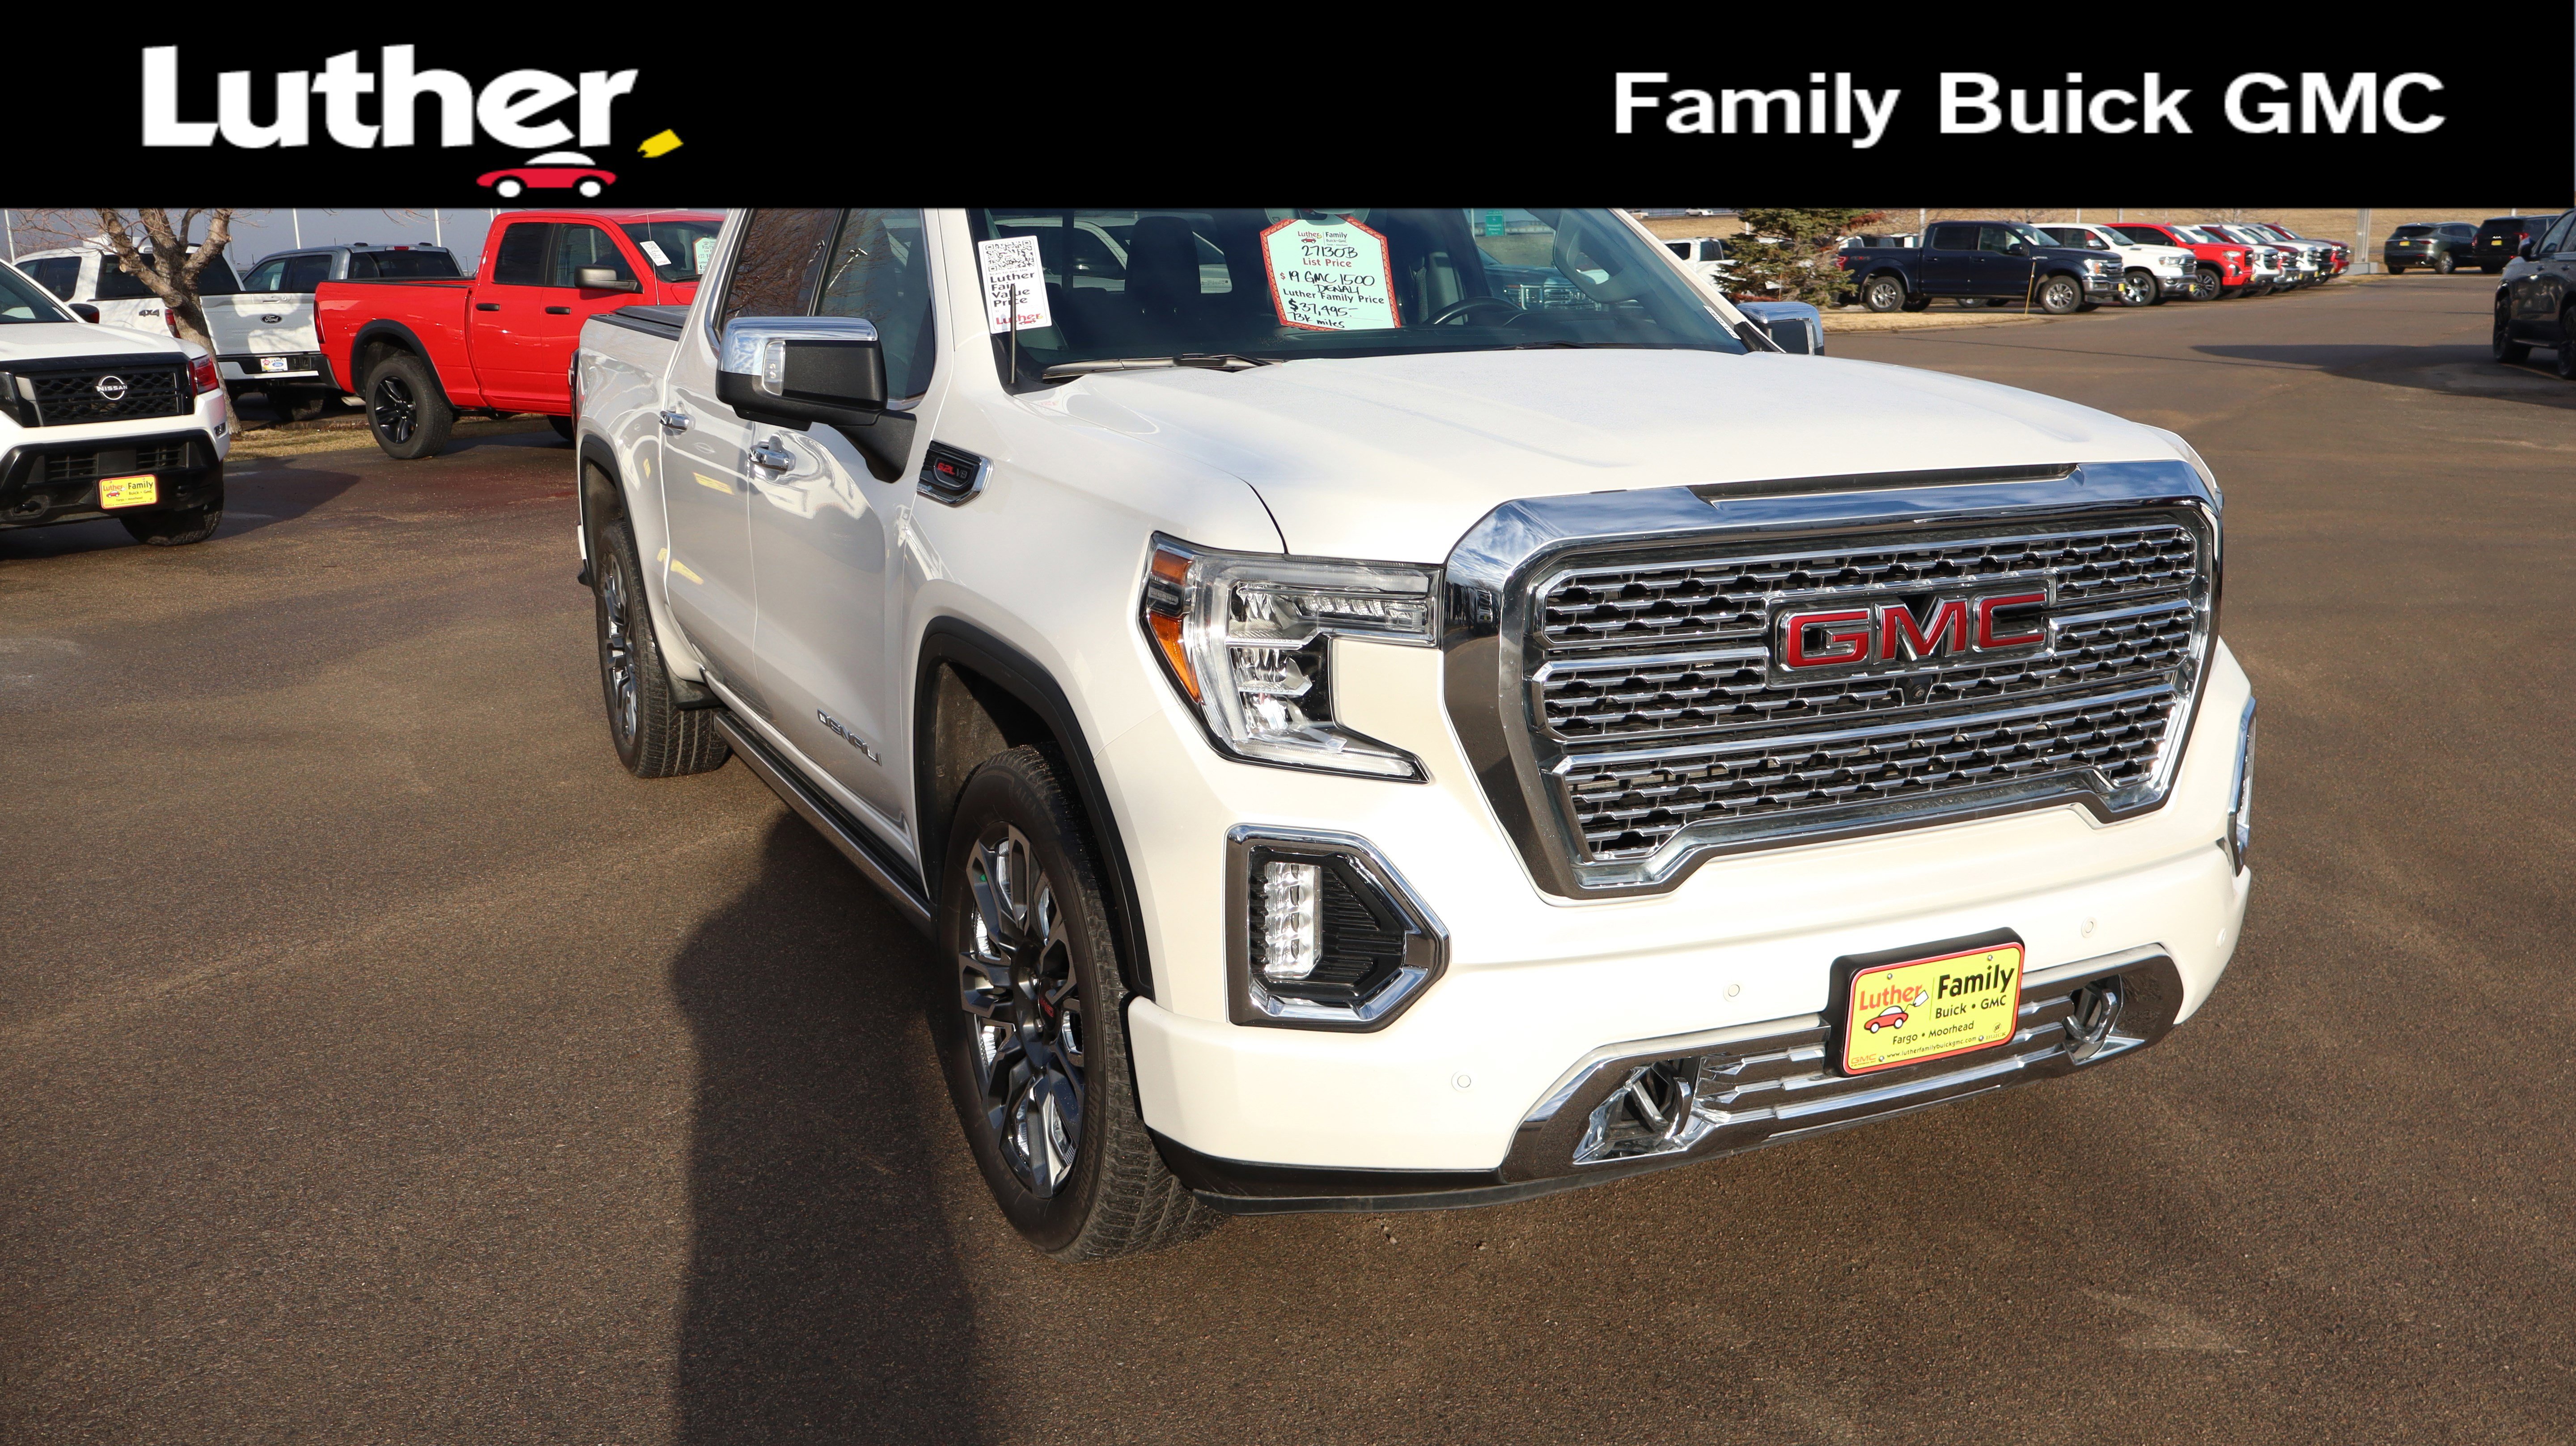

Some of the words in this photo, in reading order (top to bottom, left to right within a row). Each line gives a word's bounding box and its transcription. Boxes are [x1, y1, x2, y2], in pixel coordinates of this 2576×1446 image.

[1301, 245, 1358, 259] 27130B
[1302, 258, 1321, 266] List
[1325, 259, 1352, 267] Price
[990, 272, 1034, 283] Luther
[1305, 271, 1337, 284] GMC
[1340, 274, 1375, 286] 1500
[1283, 288, 1316, 298] Luther
[1321, 292, 1353, 303] Family
[1358, 294, 1385, 304] Price
[996, 313, 1041, 325] Luher
[128, 481, 153, 489] Family
[1779, 588, 2047, 671] GMC
[817, 708, 882, 767] DENALI
[1859, 984, 1922, 1011] Luther
[1937, 964, 2015, 1000] Family
[1936, 1003, 1966, 1019] Buick
[1981, 995, 2007, 1009] GMC
[1893, 1034, 1918, 1045] Fargo
[1928, 1021, 1974, 1038] Moorhead
[1986, 1032, 2006, 1040] BUICK
[1887, 1037, 1976, 1058] www.lutherfamilybuickgmc.com
[1851, 1053, 1877, 1064] GMC
